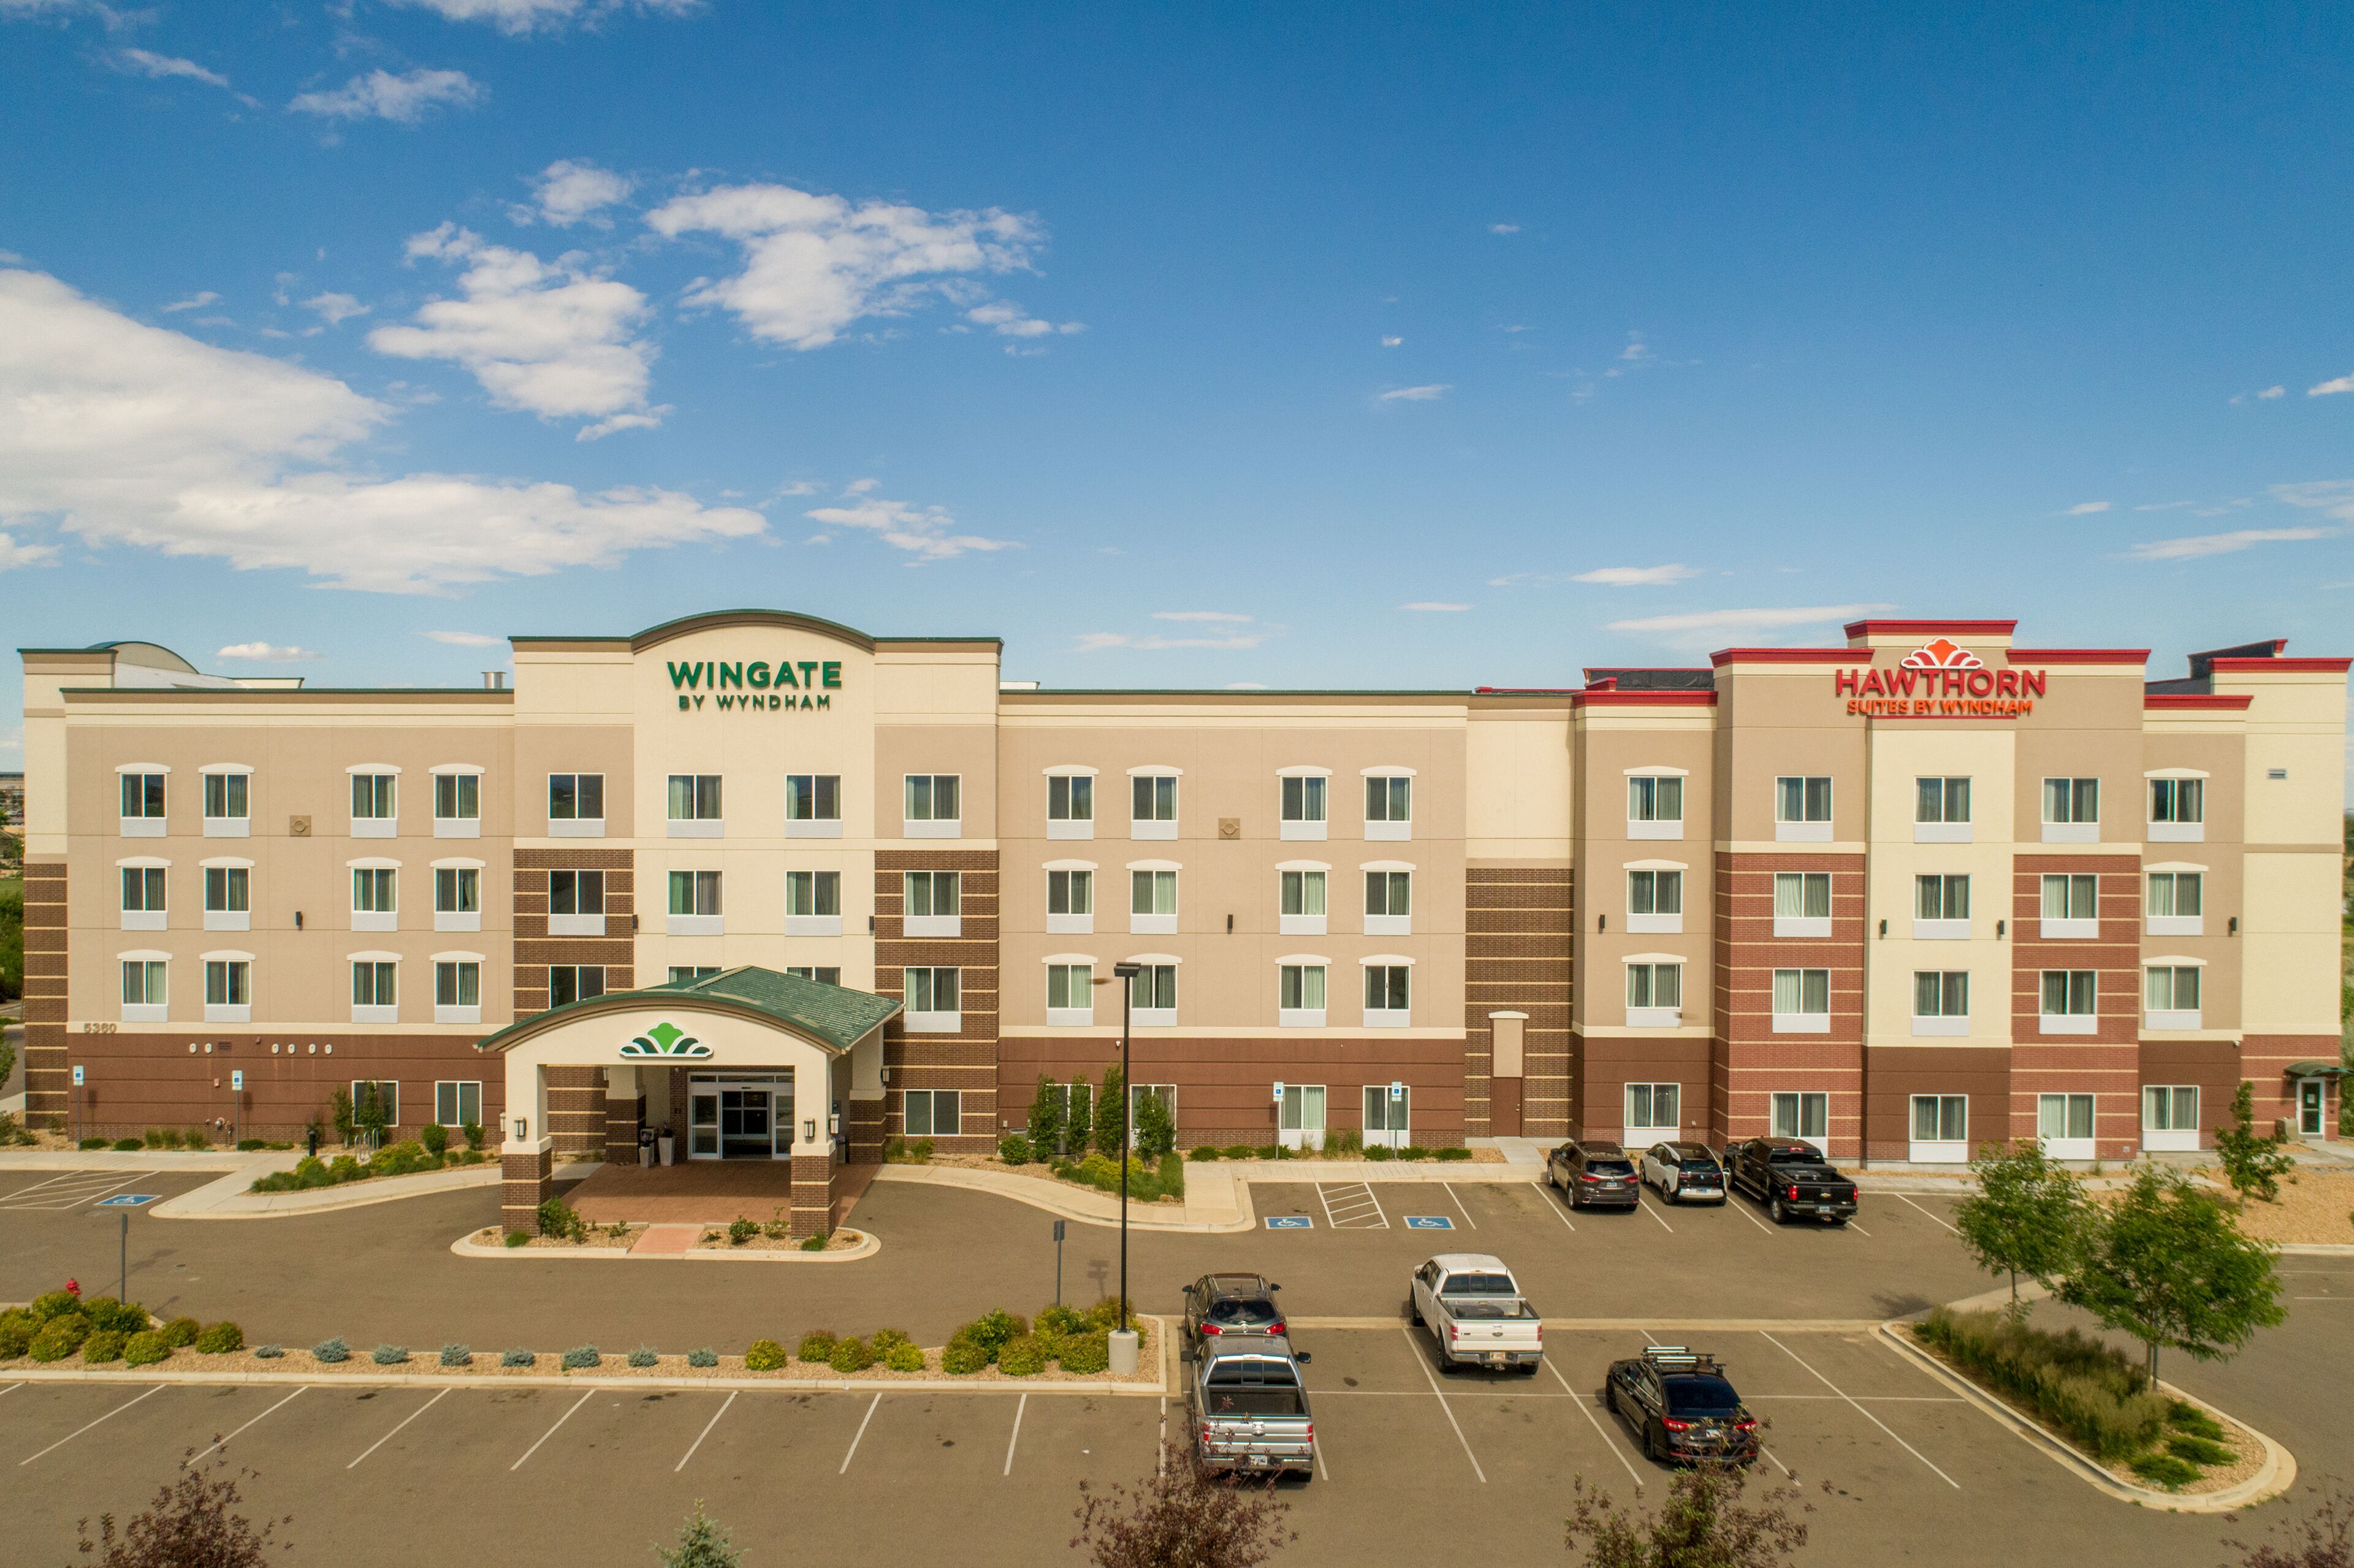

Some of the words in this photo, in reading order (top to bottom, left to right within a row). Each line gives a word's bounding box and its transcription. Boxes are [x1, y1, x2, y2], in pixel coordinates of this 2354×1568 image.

[667, 661, 842, 687] WINGATE
[1835, 669, 2046, 695] HAWTHORN
[679, 695, 705, 709] BY
[716, 695, 830, 709] WYNDHAM
[1847, 699, 1909, 713] SUITES
[1915, 699, 1937, 713] BY
[1940, 699, 2033, 713] WYNDHAM
[83, 1022, 117, 1034] 5360
